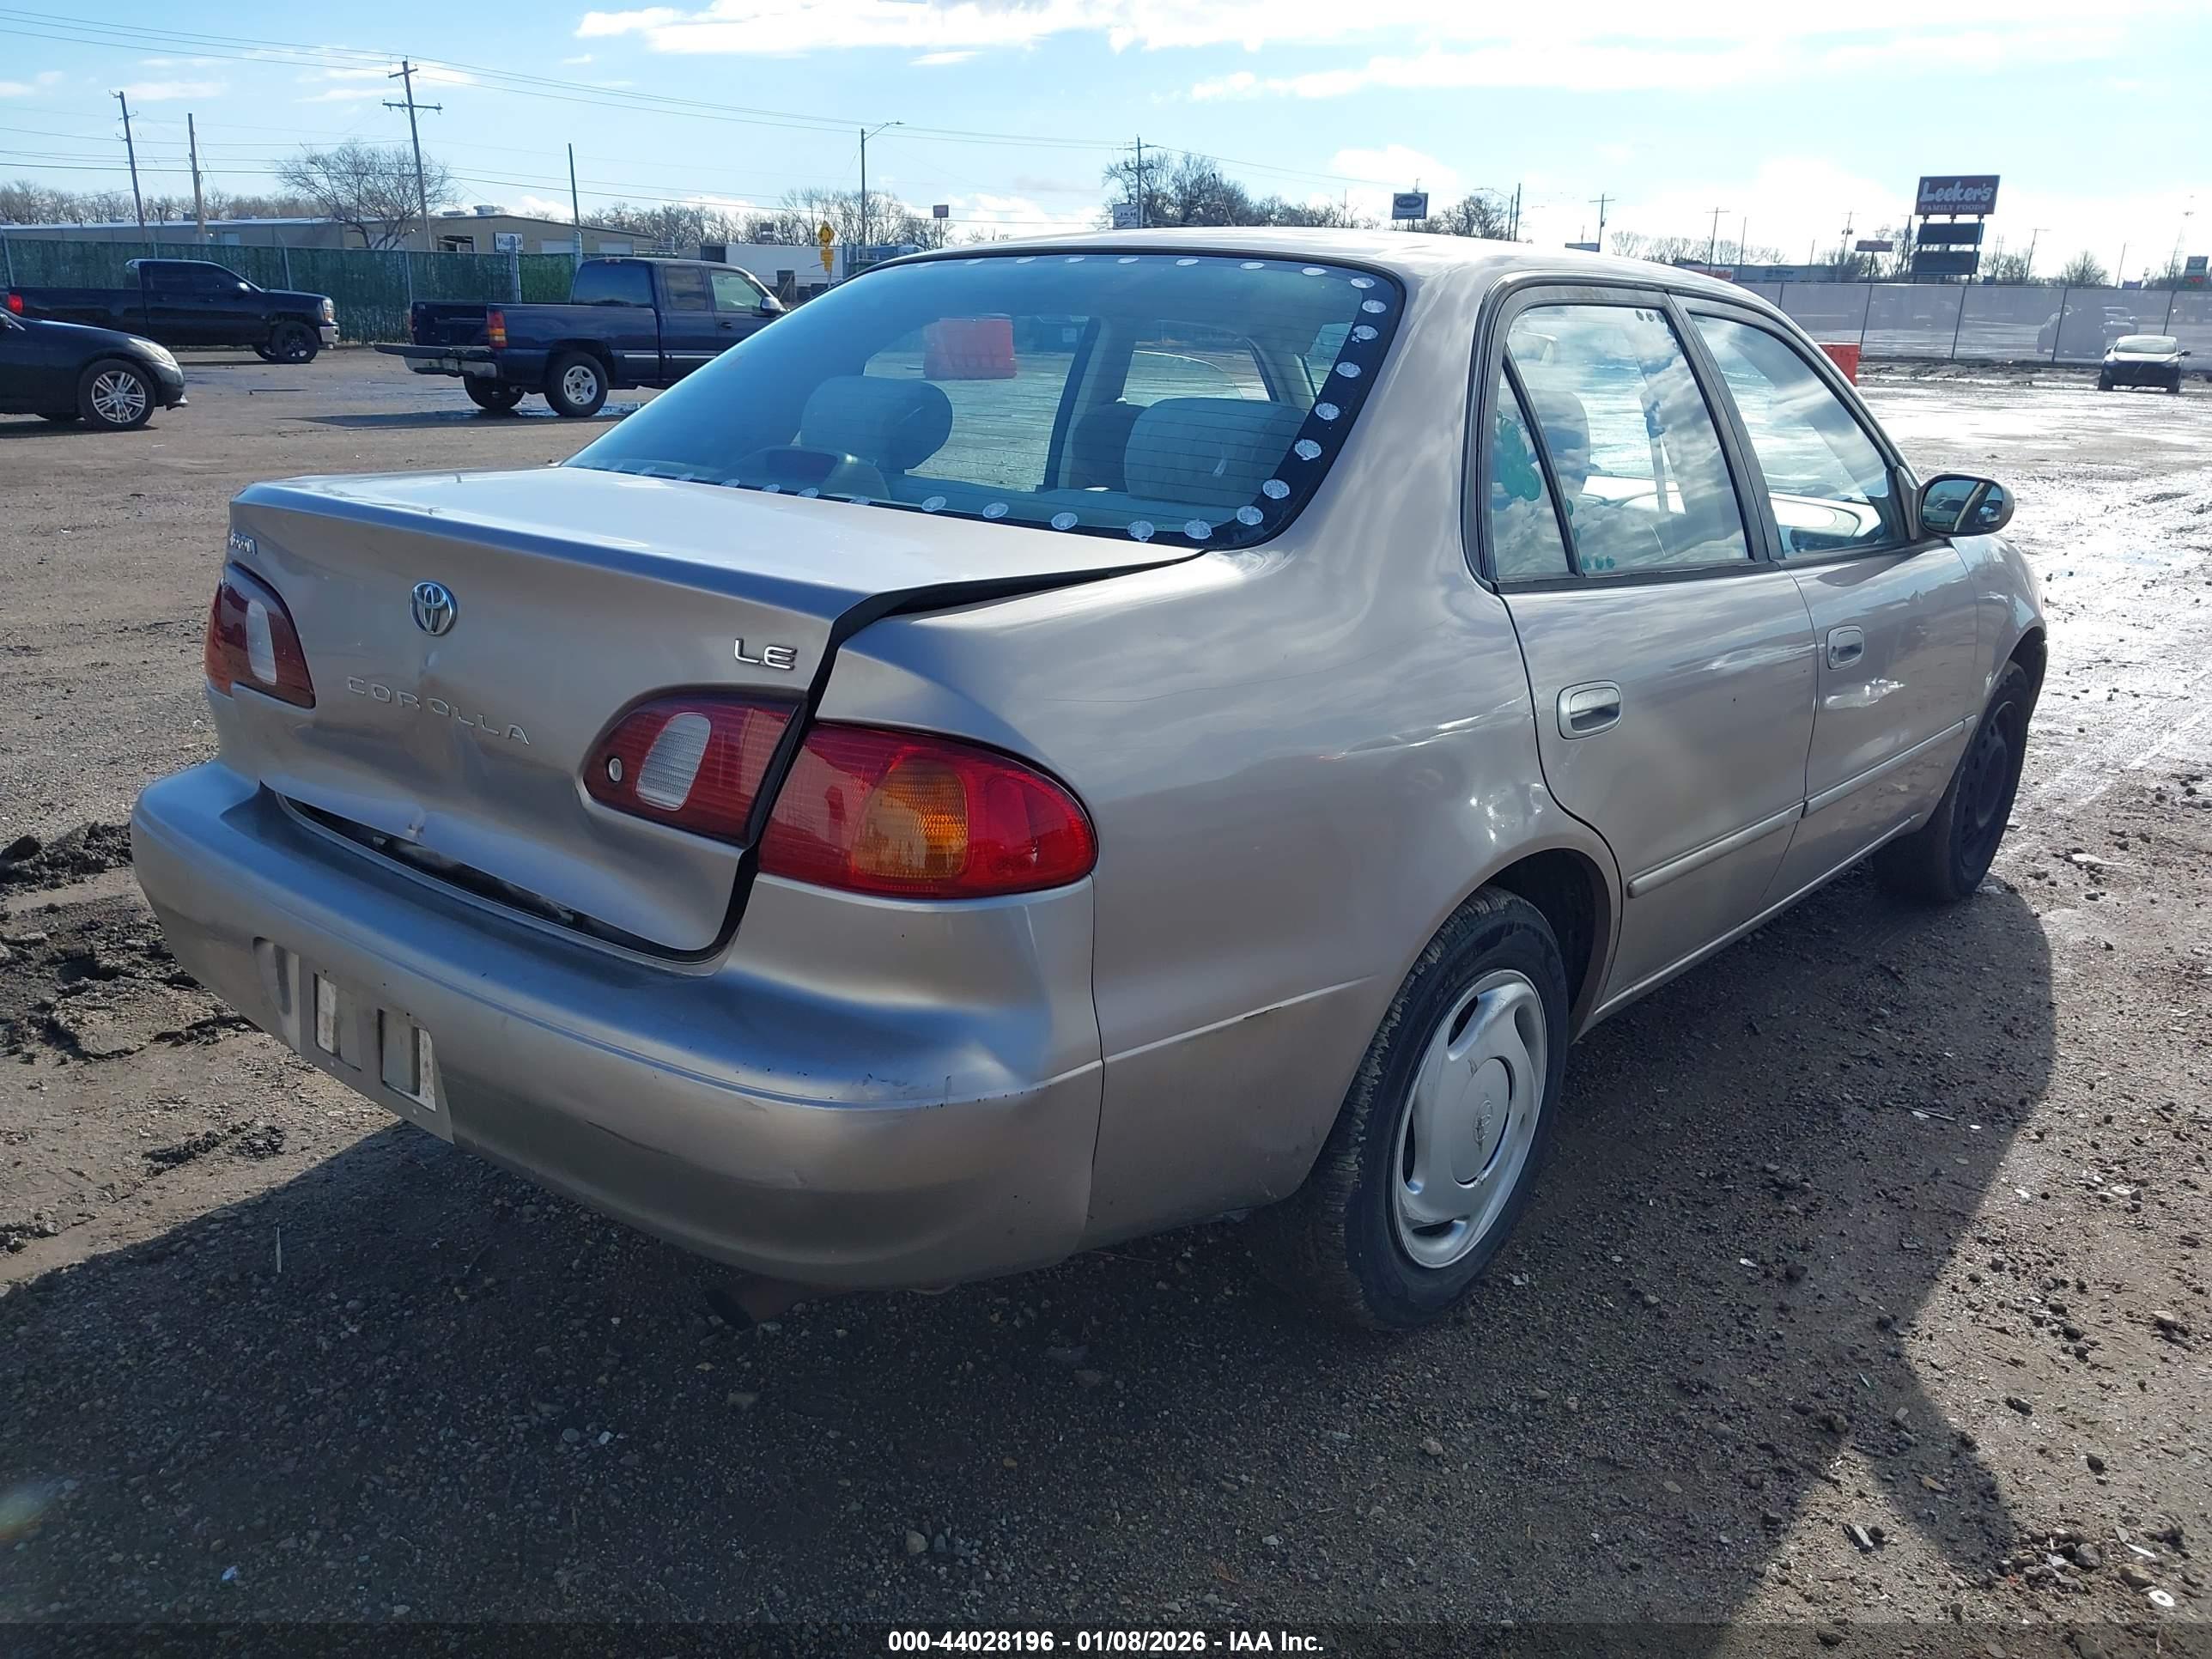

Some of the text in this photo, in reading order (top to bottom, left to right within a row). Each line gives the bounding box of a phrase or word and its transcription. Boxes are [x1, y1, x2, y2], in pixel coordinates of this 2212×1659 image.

[1920, 180, 1993, 202] Leeker's
[1921, 204, 1954, 212] FAMILY
[734, 638, 798, 670] LE
[348, 676, 530, 745] COROLLA
